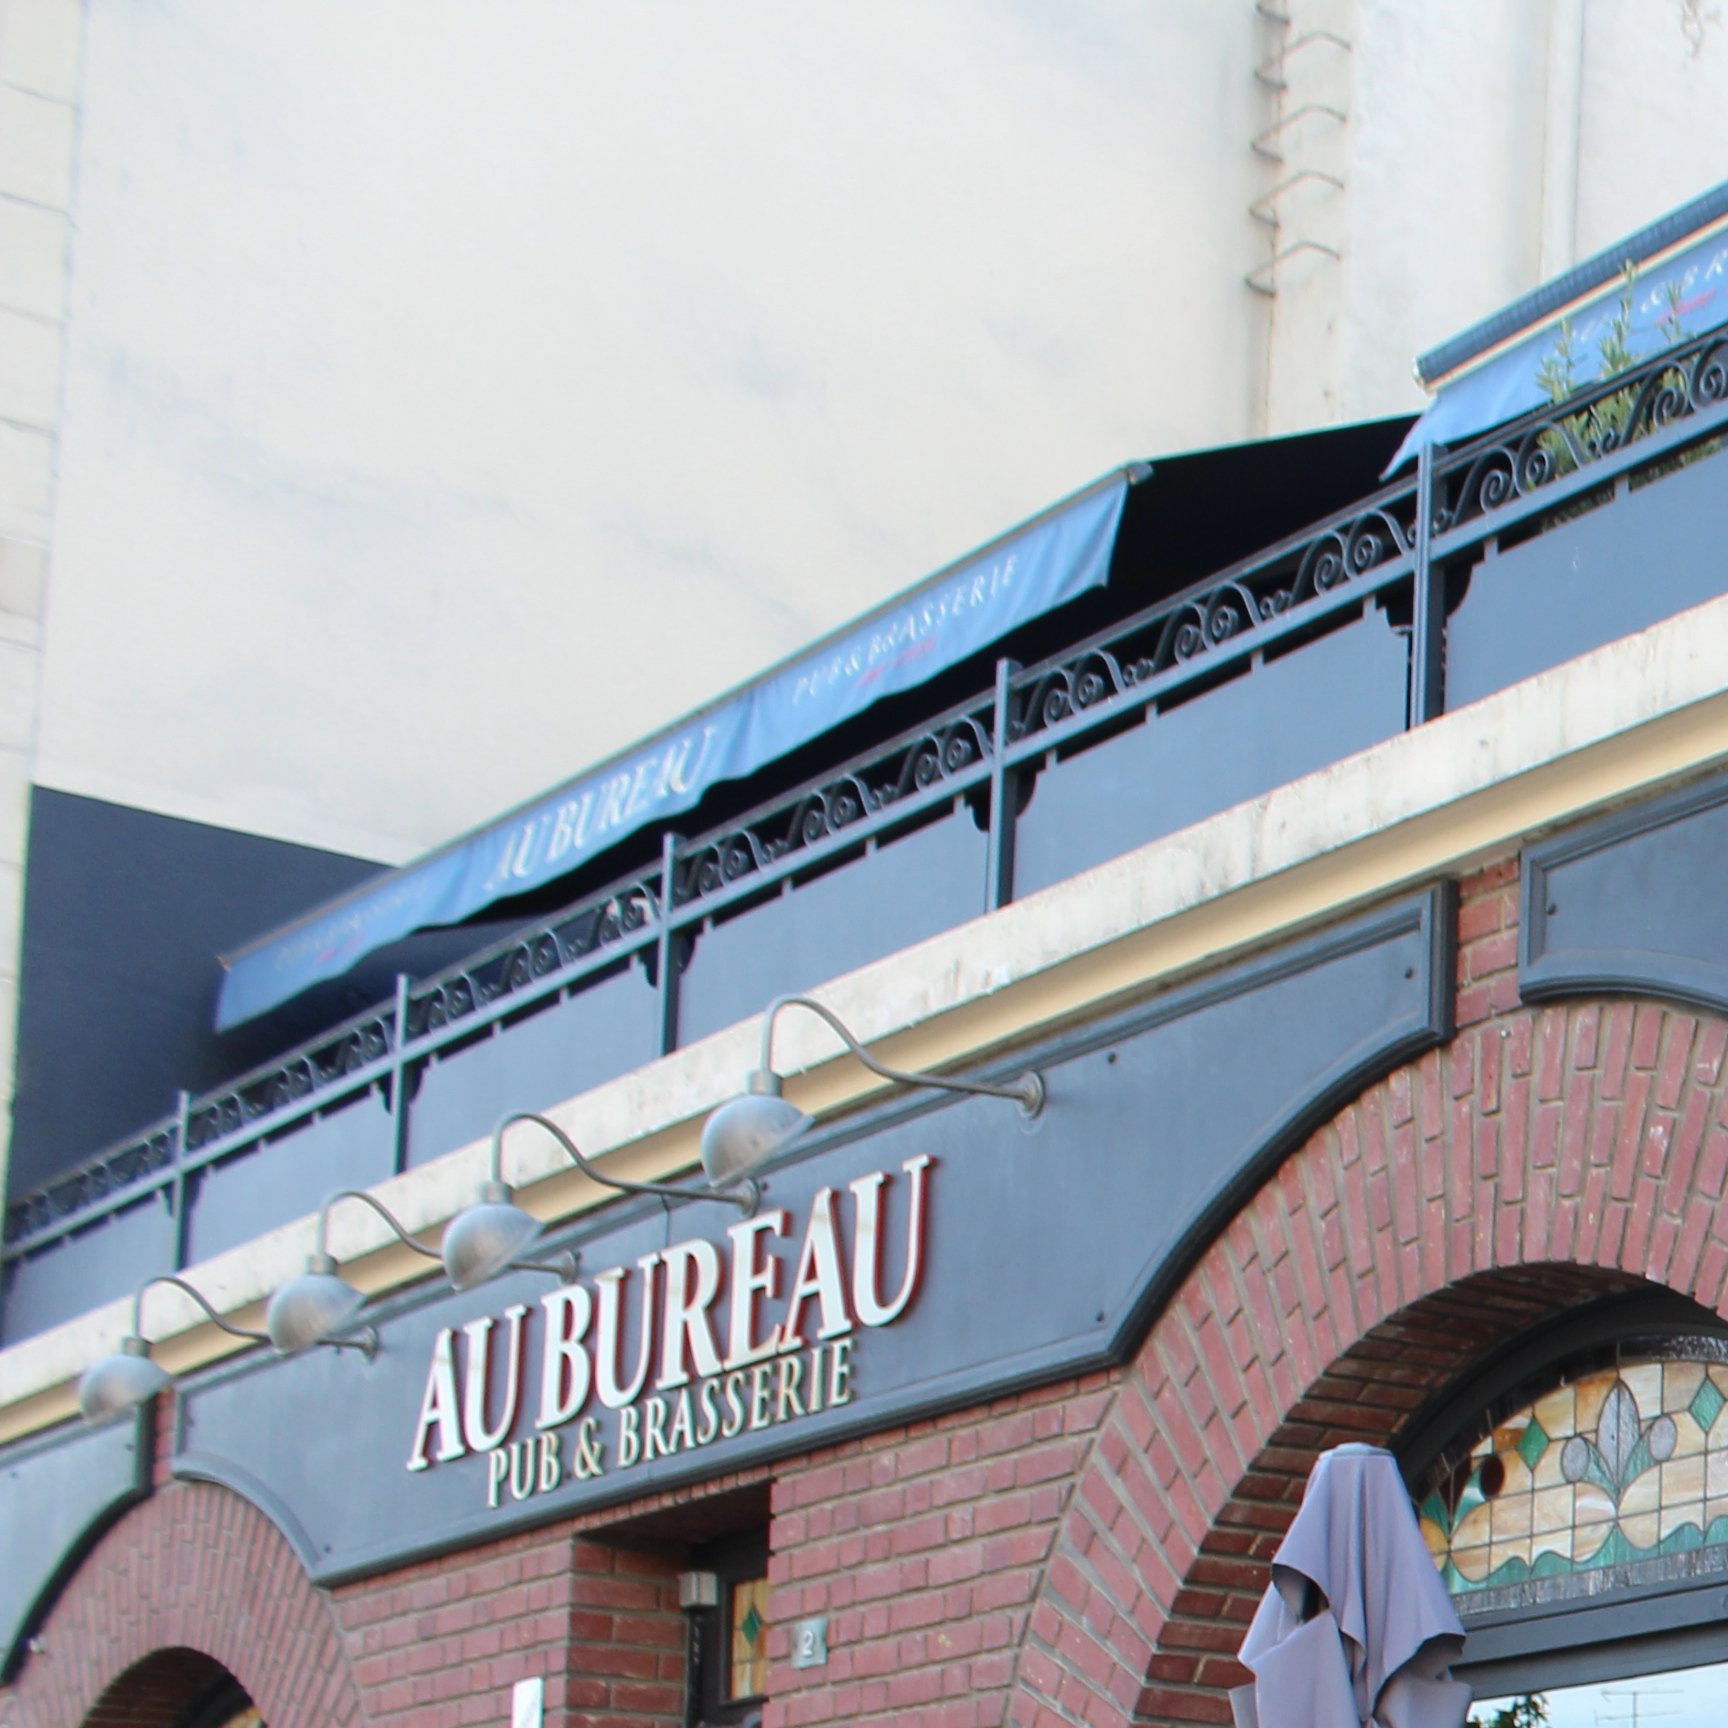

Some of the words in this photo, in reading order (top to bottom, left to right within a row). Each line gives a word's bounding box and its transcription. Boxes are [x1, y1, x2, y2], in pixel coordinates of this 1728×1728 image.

[406, 1301, 530, 1473] AU
[533, 1152, 937, 1431] BUREAU
[486, 1429, 562, 1508] PUB
[574, 1415, 604, 1481] &
[616, 1337, 857, 1470] BRASSERIE
[801, 1630, 815, 1656] 2
